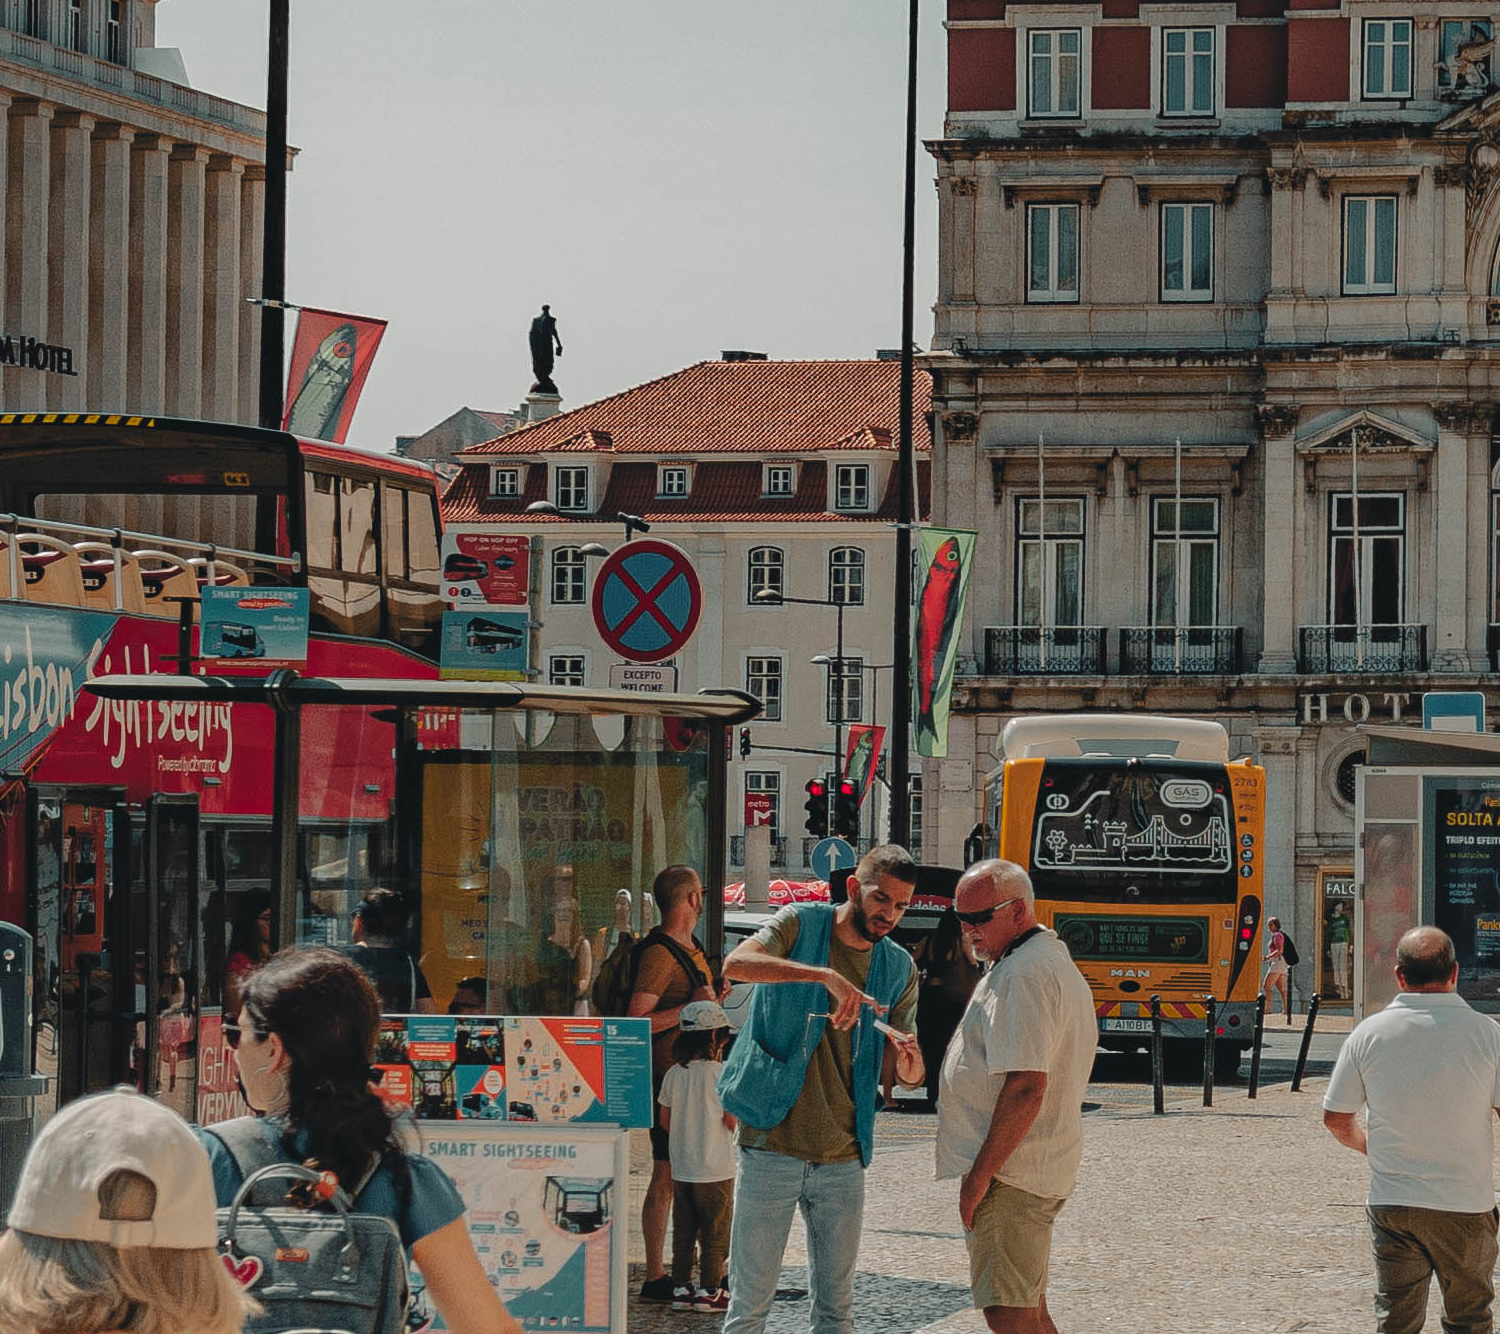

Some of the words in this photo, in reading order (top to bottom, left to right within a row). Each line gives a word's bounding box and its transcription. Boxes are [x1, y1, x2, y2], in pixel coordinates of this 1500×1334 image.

[19, 335, 79, 377] HOTEL
[623, 670, 662, 680] EXCEPTO
[1299, 692, 1411, 724] HOT
[747, 800, 770, 808] metro
[1446, 812, 1493, 826] SOLTA
[1445, 835, 1475, 845] TRIPLO
[1326, 883, 1356, 895] FALC
[1109, 969, 1150, 978] MAN
[606, 1025, 618, 1036] 15
[428, 1141, 477, 1157] SMART
[483, 1141, 578, 1159] SIGHTSEEING
